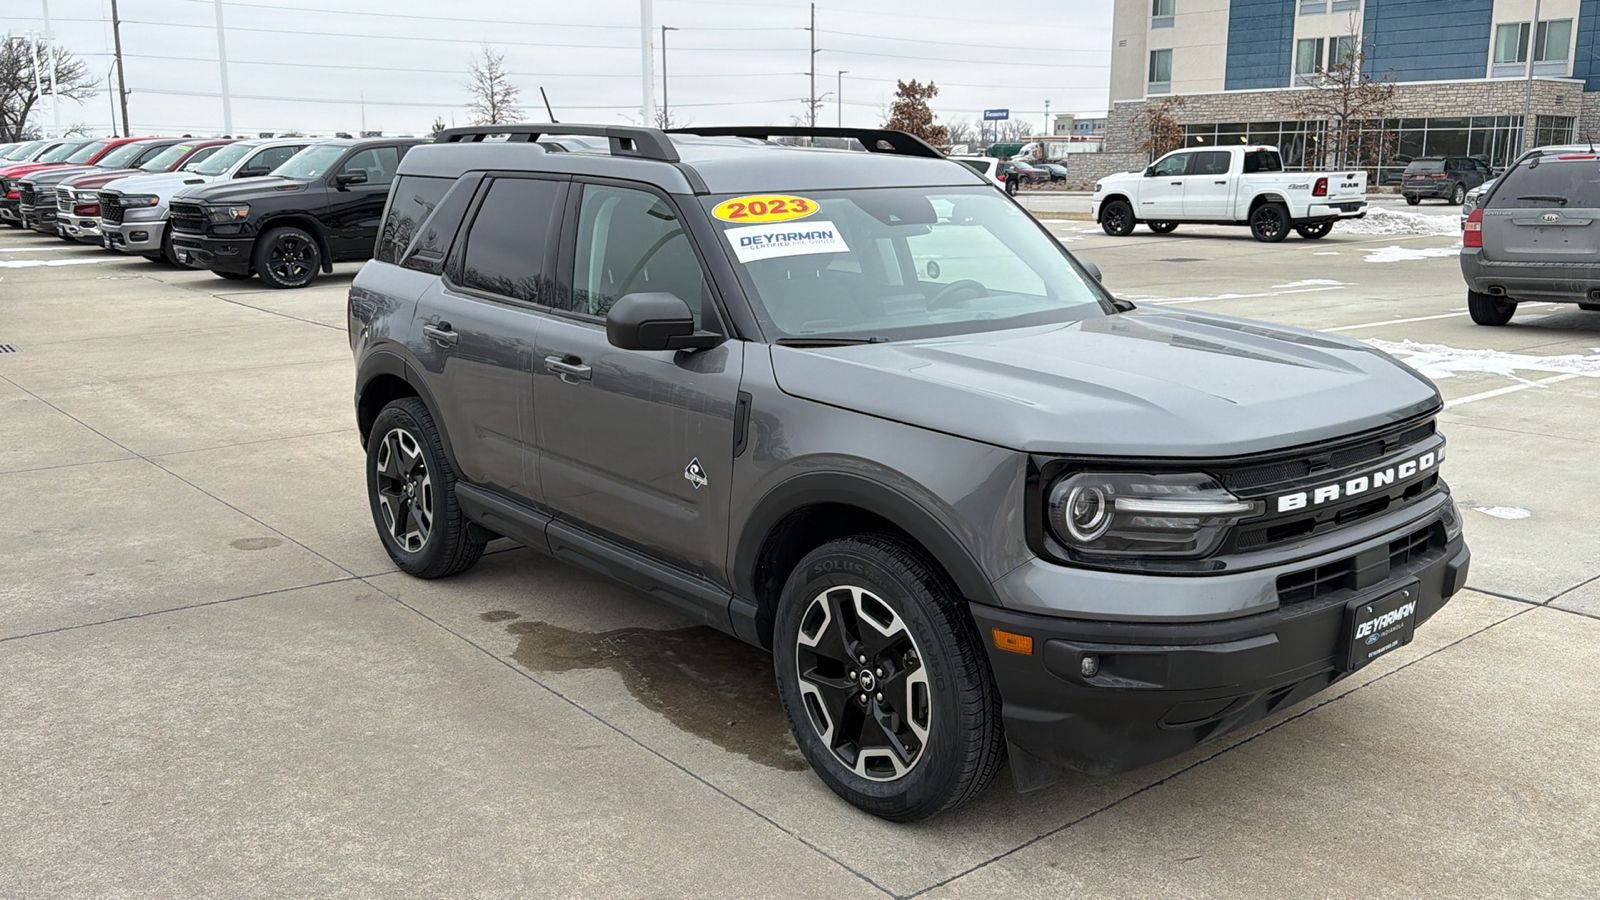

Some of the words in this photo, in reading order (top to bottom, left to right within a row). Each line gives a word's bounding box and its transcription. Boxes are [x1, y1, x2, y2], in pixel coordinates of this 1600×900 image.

[728, 199, 809, 218] 2023
[740, 231, 833, 247] DEYARMAN
[750, 242, 790, 251] CERTIFIED
[1278, 452, 1434, 512] BRONCO
[815, 560, 864, 575] SOLUS
[1355, 601, 1416, 639] DEYARMAN
